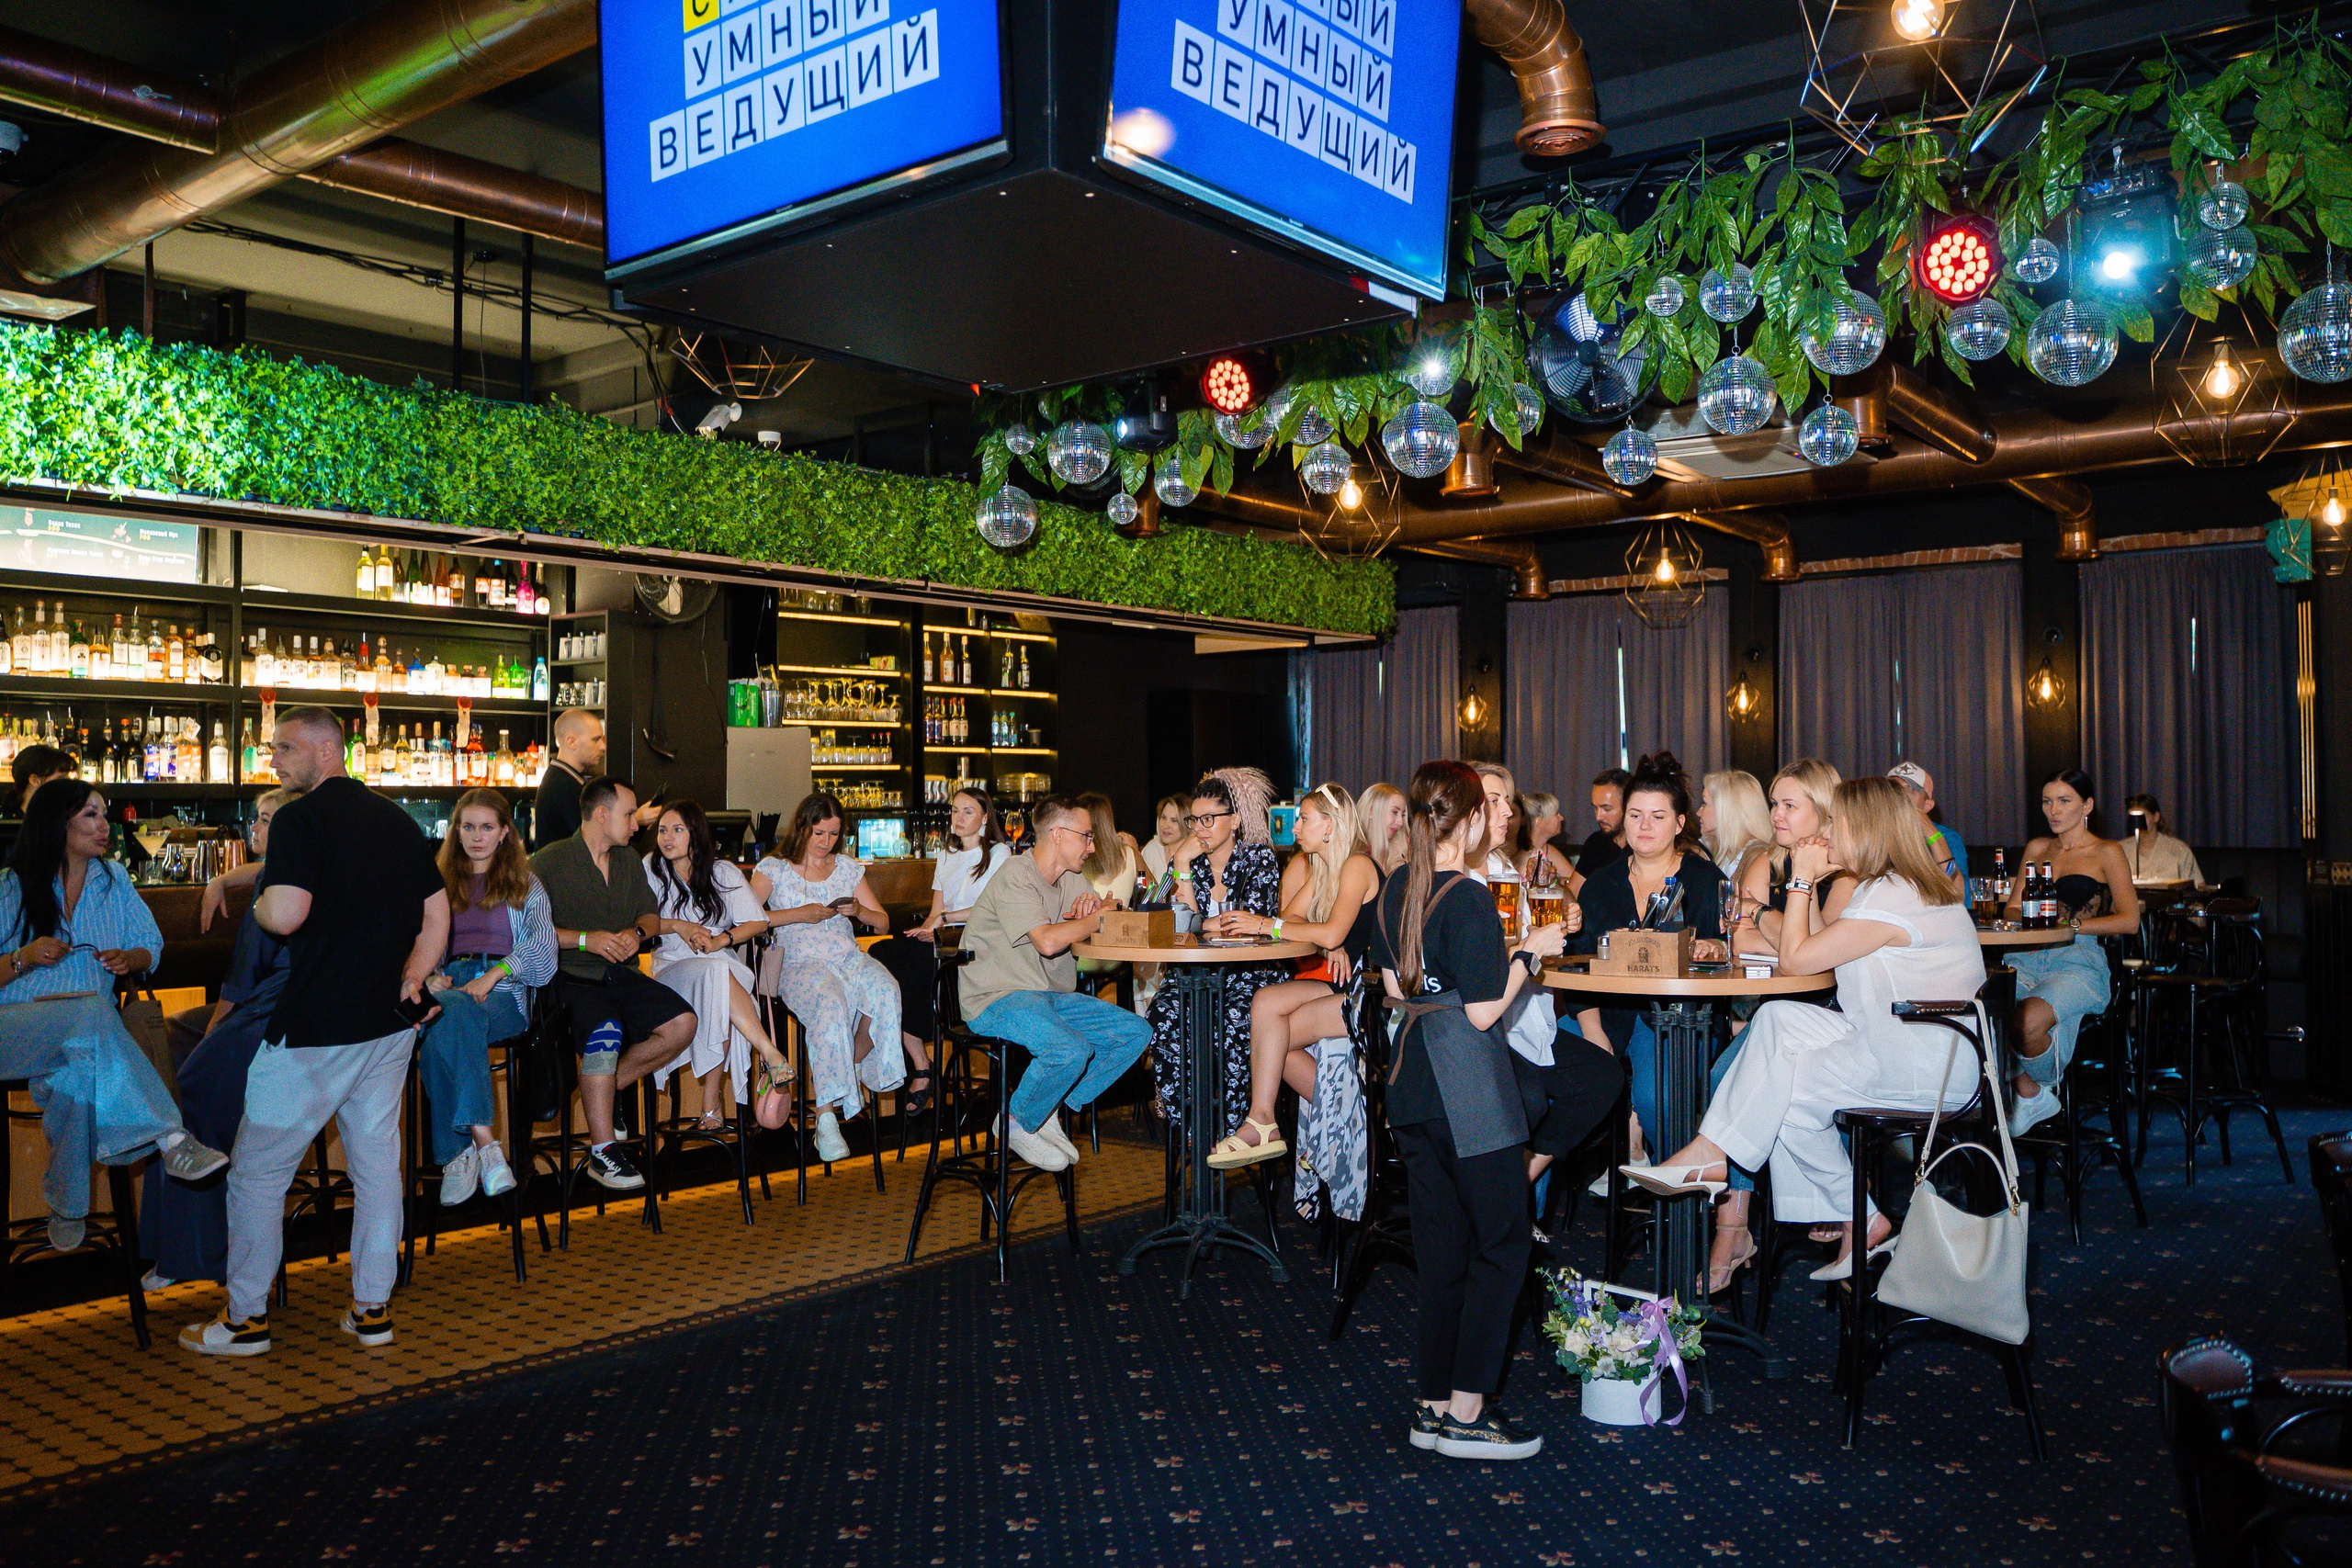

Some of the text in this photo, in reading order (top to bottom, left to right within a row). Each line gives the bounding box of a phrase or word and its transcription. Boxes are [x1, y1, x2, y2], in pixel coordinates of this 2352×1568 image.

[659, 15, 929, 171] ВЕДУЩИЙ
[1182, 37, 1409, 192] ВЕДУЩИЙ
[1229, 0, 1385, 110] УМНЫЙ
[1625, 936, 1661, 949] VOLGOGRAD
